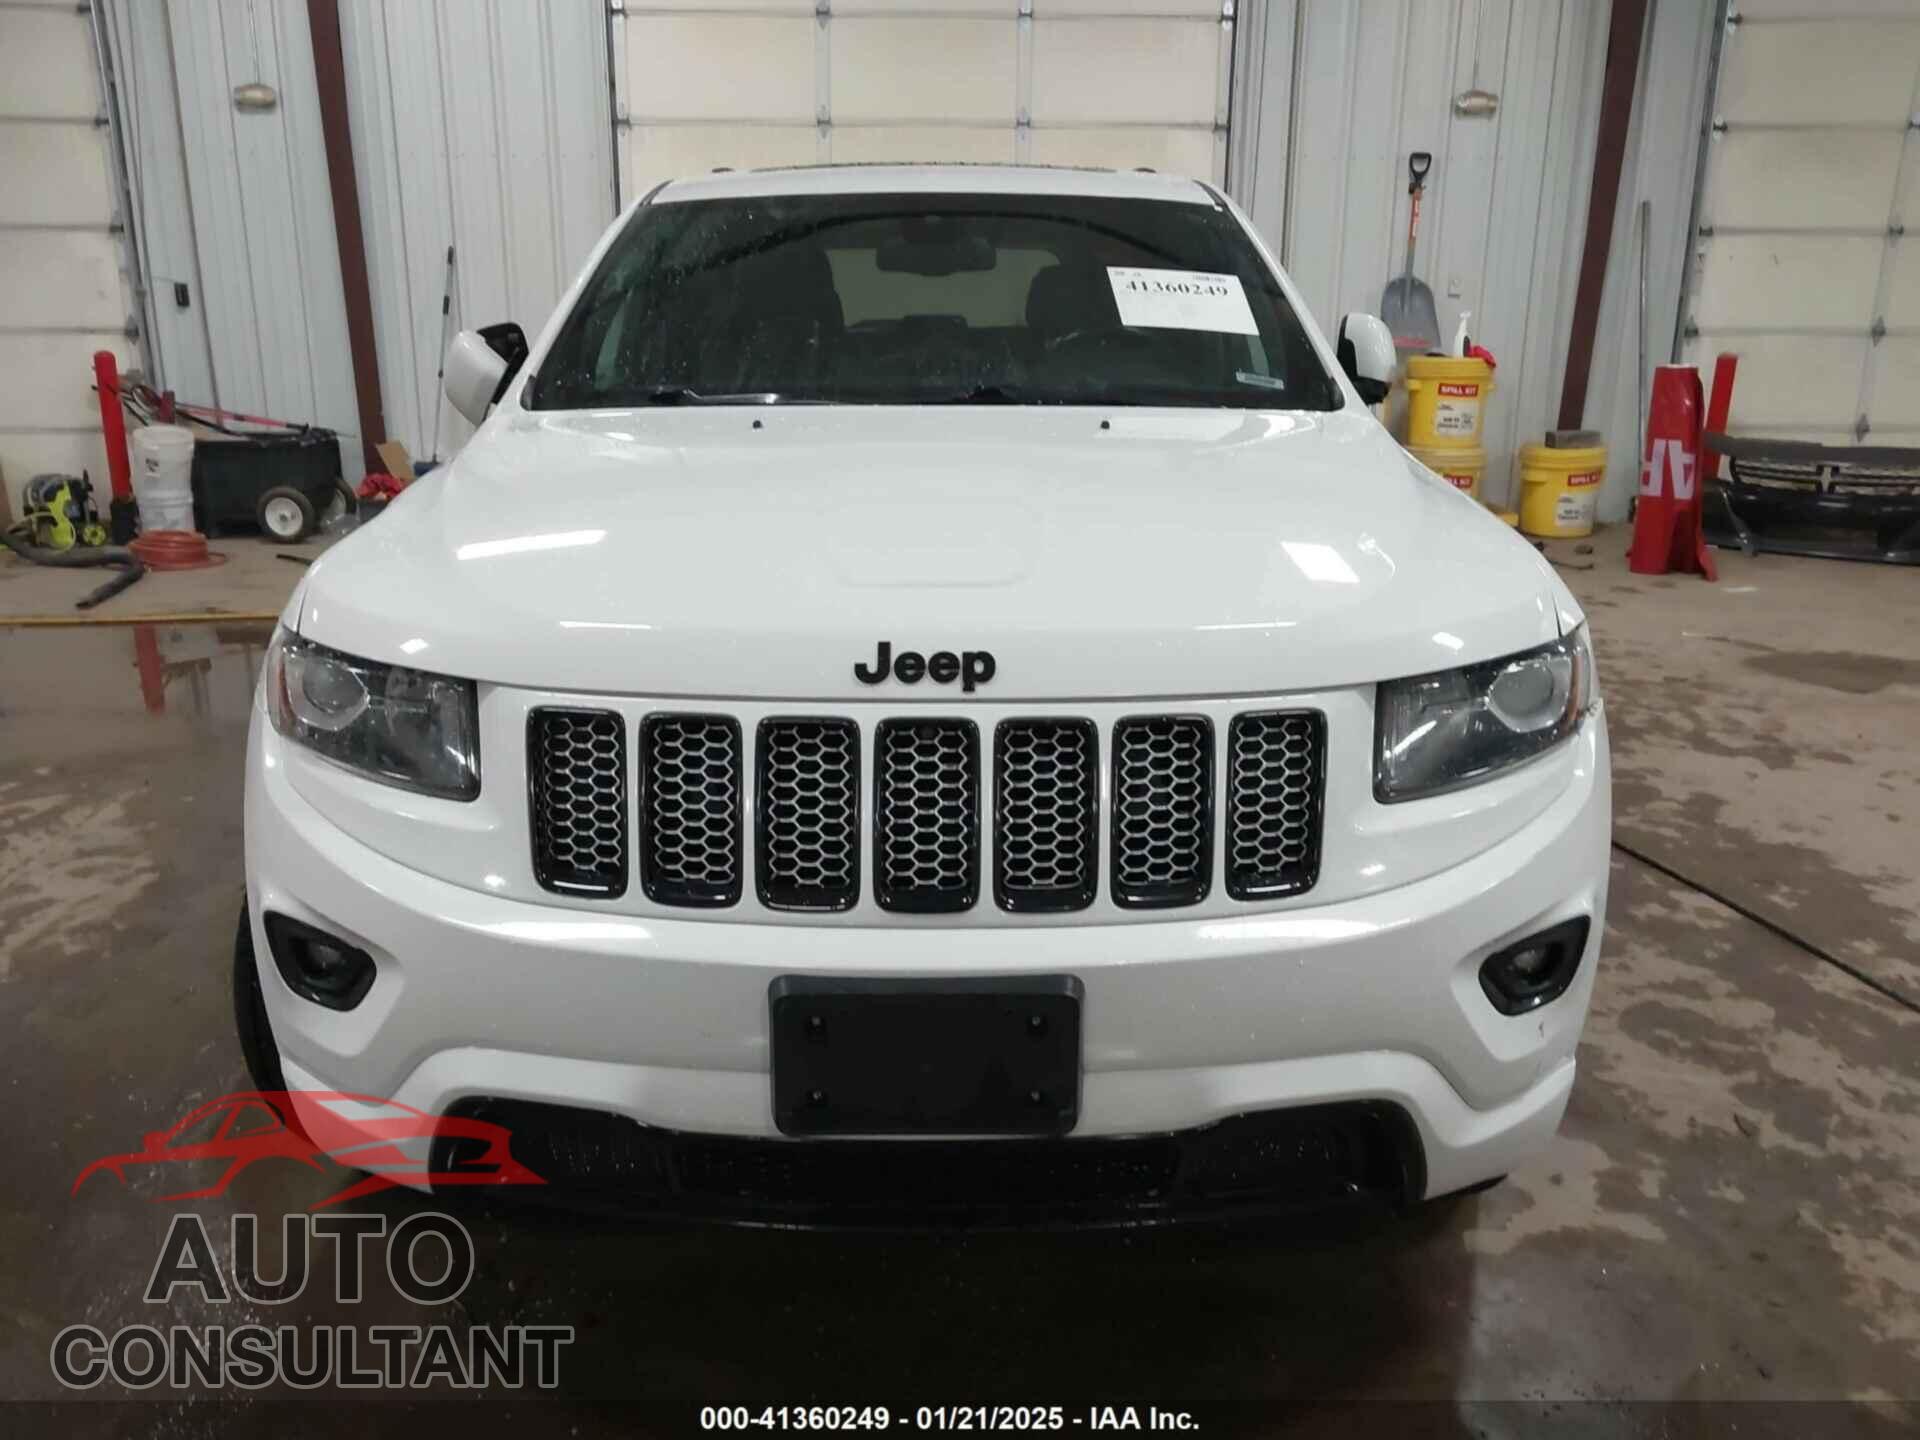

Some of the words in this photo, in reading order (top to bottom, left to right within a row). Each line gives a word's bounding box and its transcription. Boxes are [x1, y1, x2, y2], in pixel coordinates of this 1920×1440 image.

[1125, 280, 1229, 297] 41360249
[1440, 385, 1463, 395] SPILL
[1464, 386, 1477, 395] KIT
[854, 641, 996, 692] Jeep
